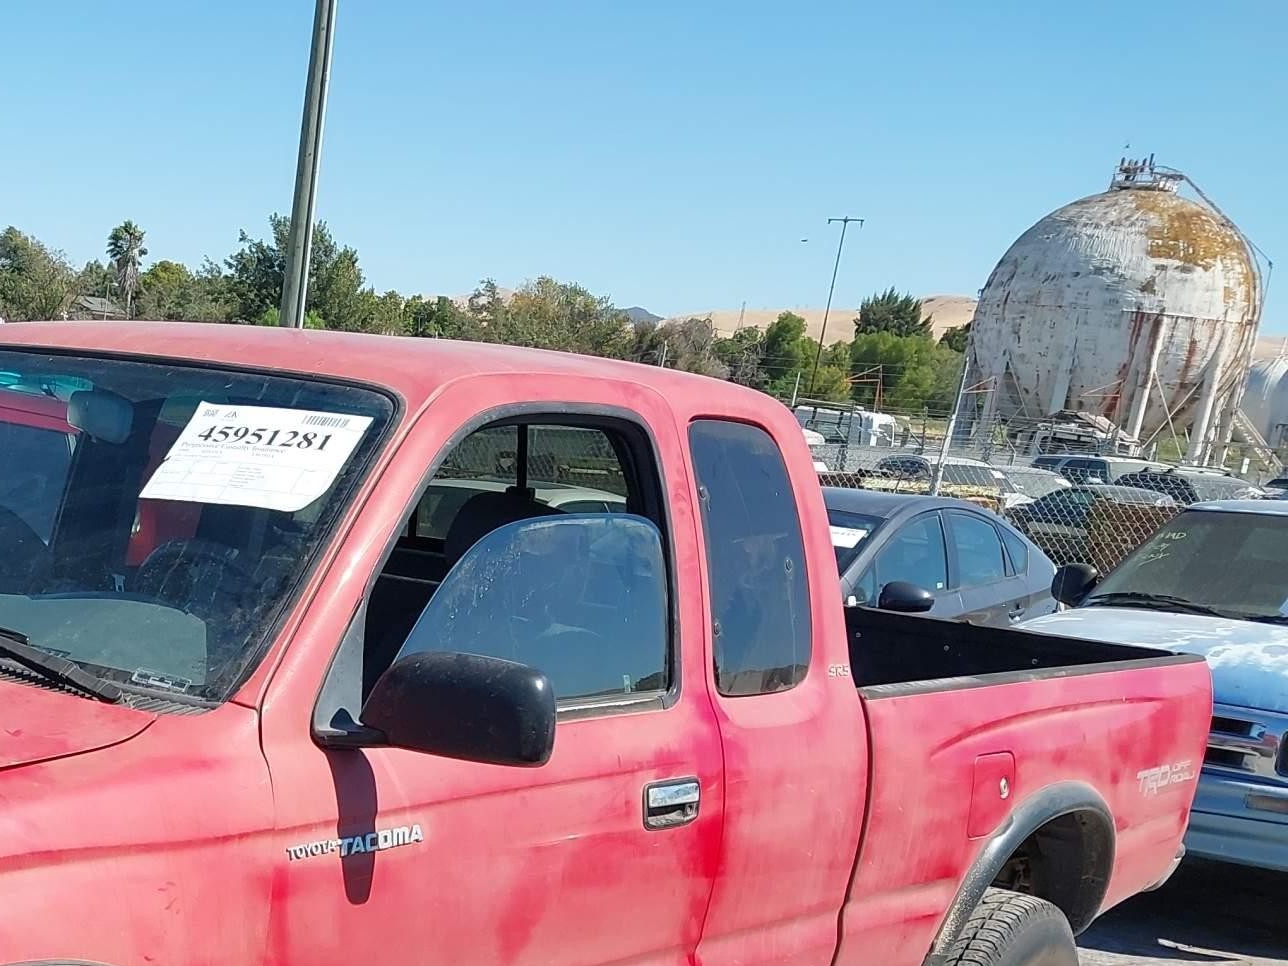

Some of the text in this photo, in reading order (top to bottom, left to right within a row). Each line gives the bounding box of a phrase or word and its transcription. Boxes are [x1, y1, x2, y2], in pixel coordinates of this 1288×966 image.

[198, 425, 333, 452] 45951281
[286, 824, 424, 860] TOYOTA TACOMA
